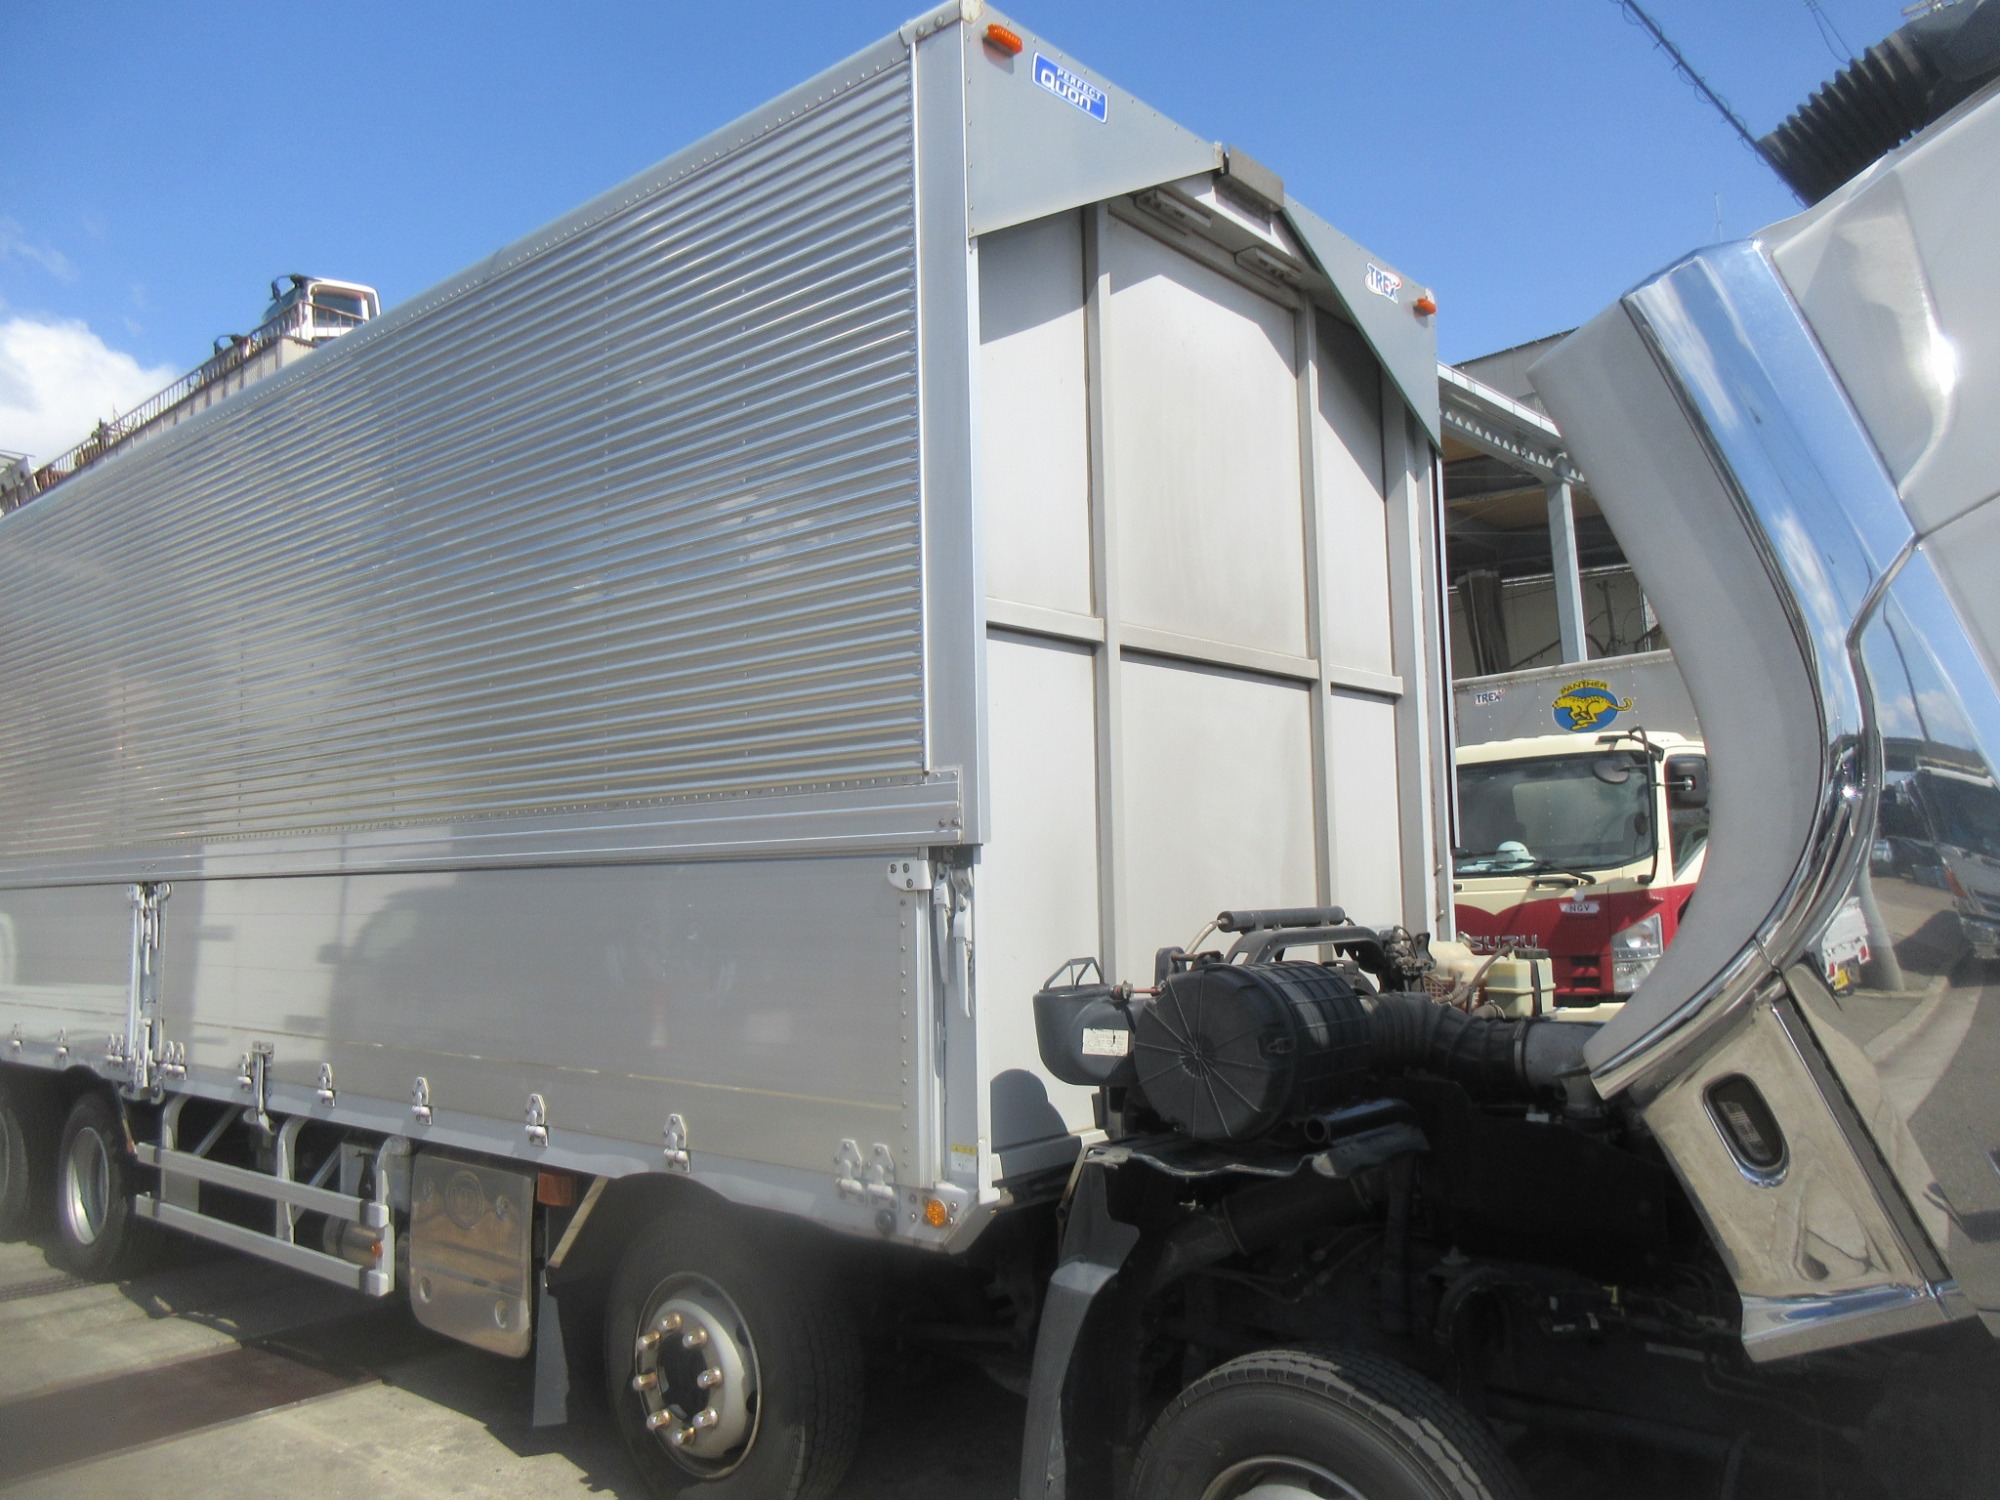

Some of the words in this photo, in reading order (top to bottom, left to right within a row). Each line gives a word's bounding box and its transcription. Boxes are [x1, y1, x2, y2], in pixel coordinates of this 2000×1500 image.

[1040, 69, 1092, 111] Quon
[1057, 69, 1102, 100] PERFECT
[1368, 265, 1399, 298] TREX
[1560, 681, 1608, 695] PANTHER
[1475, 691, 1502, 704] TREX
[1569, 904, 1591, 913] NGV
[1470, 934, 1538, 951] SUZU
